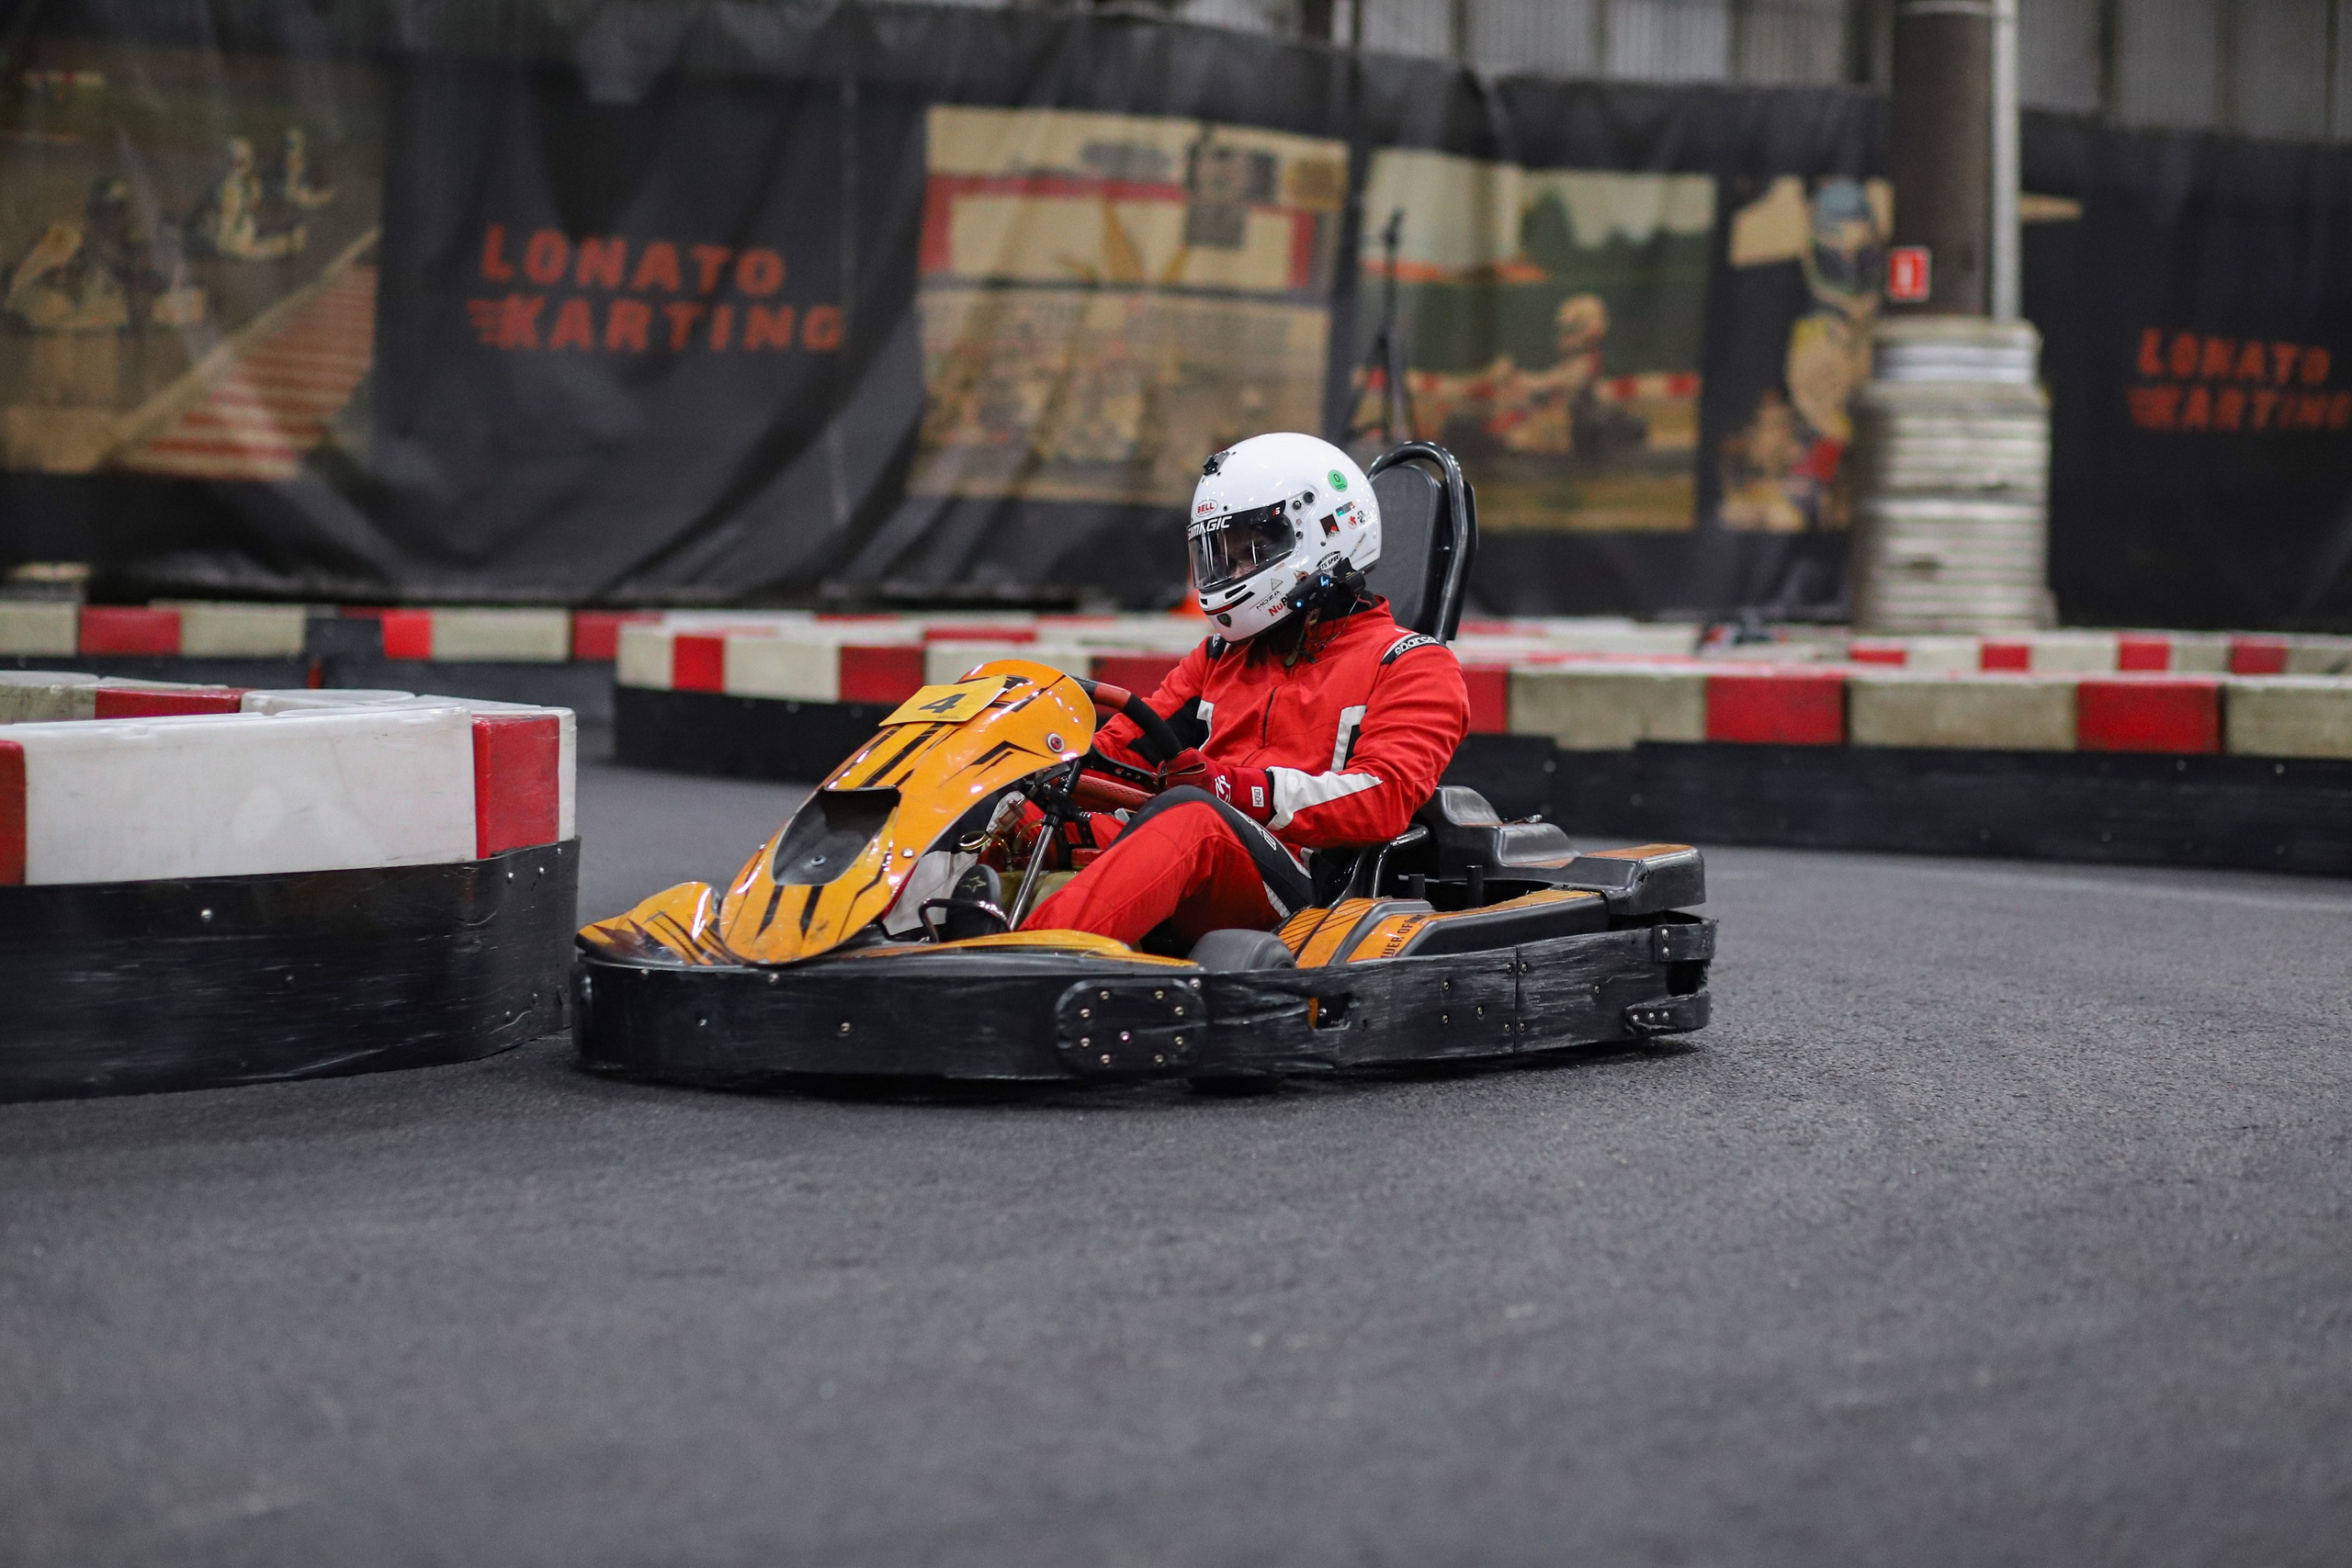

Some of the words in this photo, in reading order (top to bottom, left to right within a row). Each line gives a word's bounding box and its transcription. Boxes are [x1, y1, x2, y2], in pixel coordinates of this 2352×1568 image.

[481, 223, 786, 297] LONATO
[468, 292, 844, 354] KARTING
[1197, 502, 1215, 513] BELL
[1256, 590, 1280, 610] MOZA
[918, 694, 967, 714] 4
